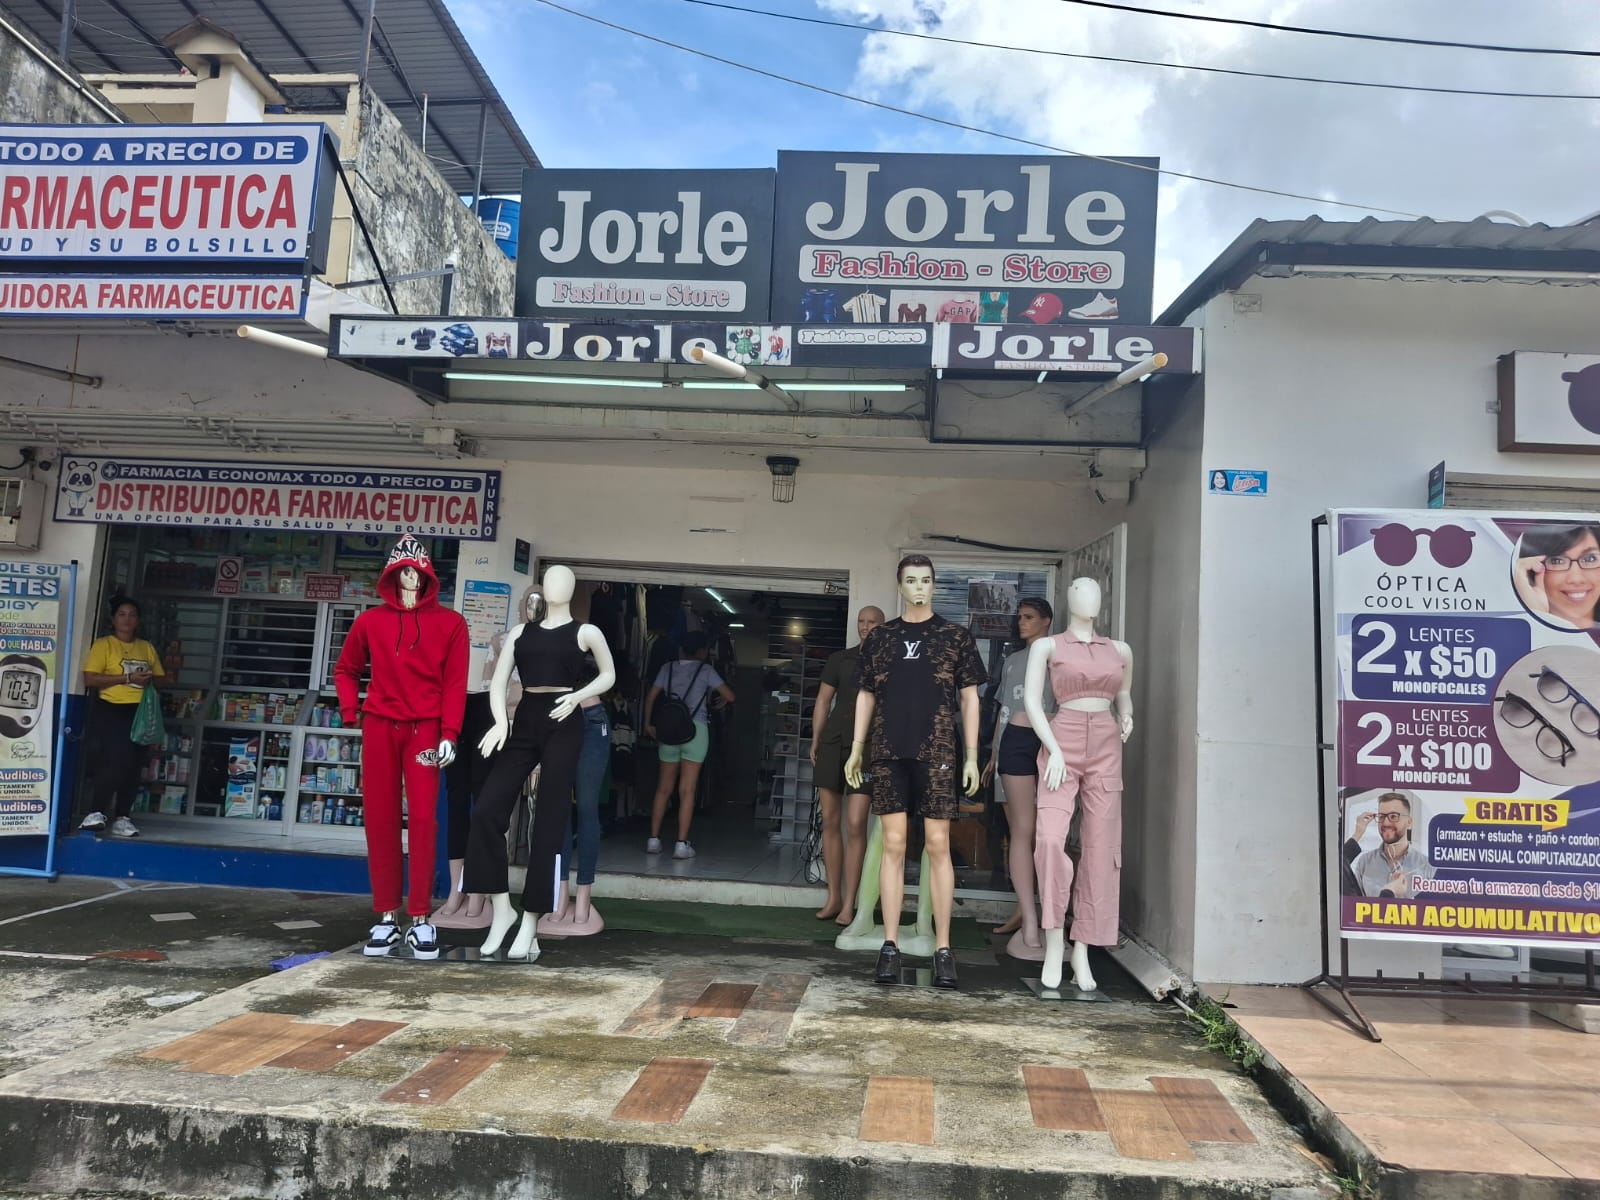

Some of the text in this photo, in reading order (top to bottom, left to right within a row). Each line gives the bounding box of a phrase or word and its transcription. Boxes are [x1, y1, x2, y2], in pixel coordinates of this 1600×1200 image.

[0, 141, 295, 161] TODO A PRECIO DE
[805, 162, 1125, 246] Jorle
[539, 190, 748, 266] Jorle
[56, 238, 69, 252] Y
[89, 238, 124, 253] SU
[145, 238, 297, 253] BOLSILLO
[812, 250, 1112, 284] Fashion - Store
[97, 284, 295, 310] FARMACEUTICA
[552, 279, 645, 305] Fashion
[666, 283, 730, 307] Store
[525, 323, 718, 365] Jorle
[801, 330, 866, 344] Fashion
[877, 330, 922, 343] Store
[958, 325, 1154, 362] Jorle
[120, 466, 474, 489] FARMACIA ECONOMAX TODO A PRECIO DE
[96, 483, 478, 525] DISTRIBUIDORA FARMACEUTICA
[94, 513, 478, 536] UNA OPCION PARA SU SALUD Y SU BOLSILLO
[36, 565, 58, 575] SU
[1377, 572, 1467, 593] ÓPTICA
[1364, 595, 1486, 611] COOL VISION
[21, 640, 52, 651] HABLA
[1357, 620, 1475, 674] 2 LENTES
[1430, 644, 1496, 679] $50
[1392, 680, 1486, 695] MONOFOCALES
[1357, 708, 1469, 766] 2 LENTES
[1396, 722, 1487, 738] BLUE BLOCK
[1421, 739, 1492, 770] $100
[1393, 770, 1471, 785] MONOFOCAL
[1475, 801, 1557, 822] GRATIS
[1436, 827, 1478, 842] (armazon
[1488, 830, 1523, 844] estuche
[1527, 833, 1533, 841] +
[1535, 832, 1558, 846] paño
[1560, 835, 1566, 843] +
[1434, 847, 1476, 861] EXAMEN
[1478, 849, 1515, 864] VISUAL
[1412, 875, 1467, 893] Renueva
[1469, 878, 1483, 894] tu
[1486, 882, 1540, 897] armazon
[1542, 881, 1582, 899] desde
[1355, 902, 1600, 935] PLAN ACUMULATIVO
